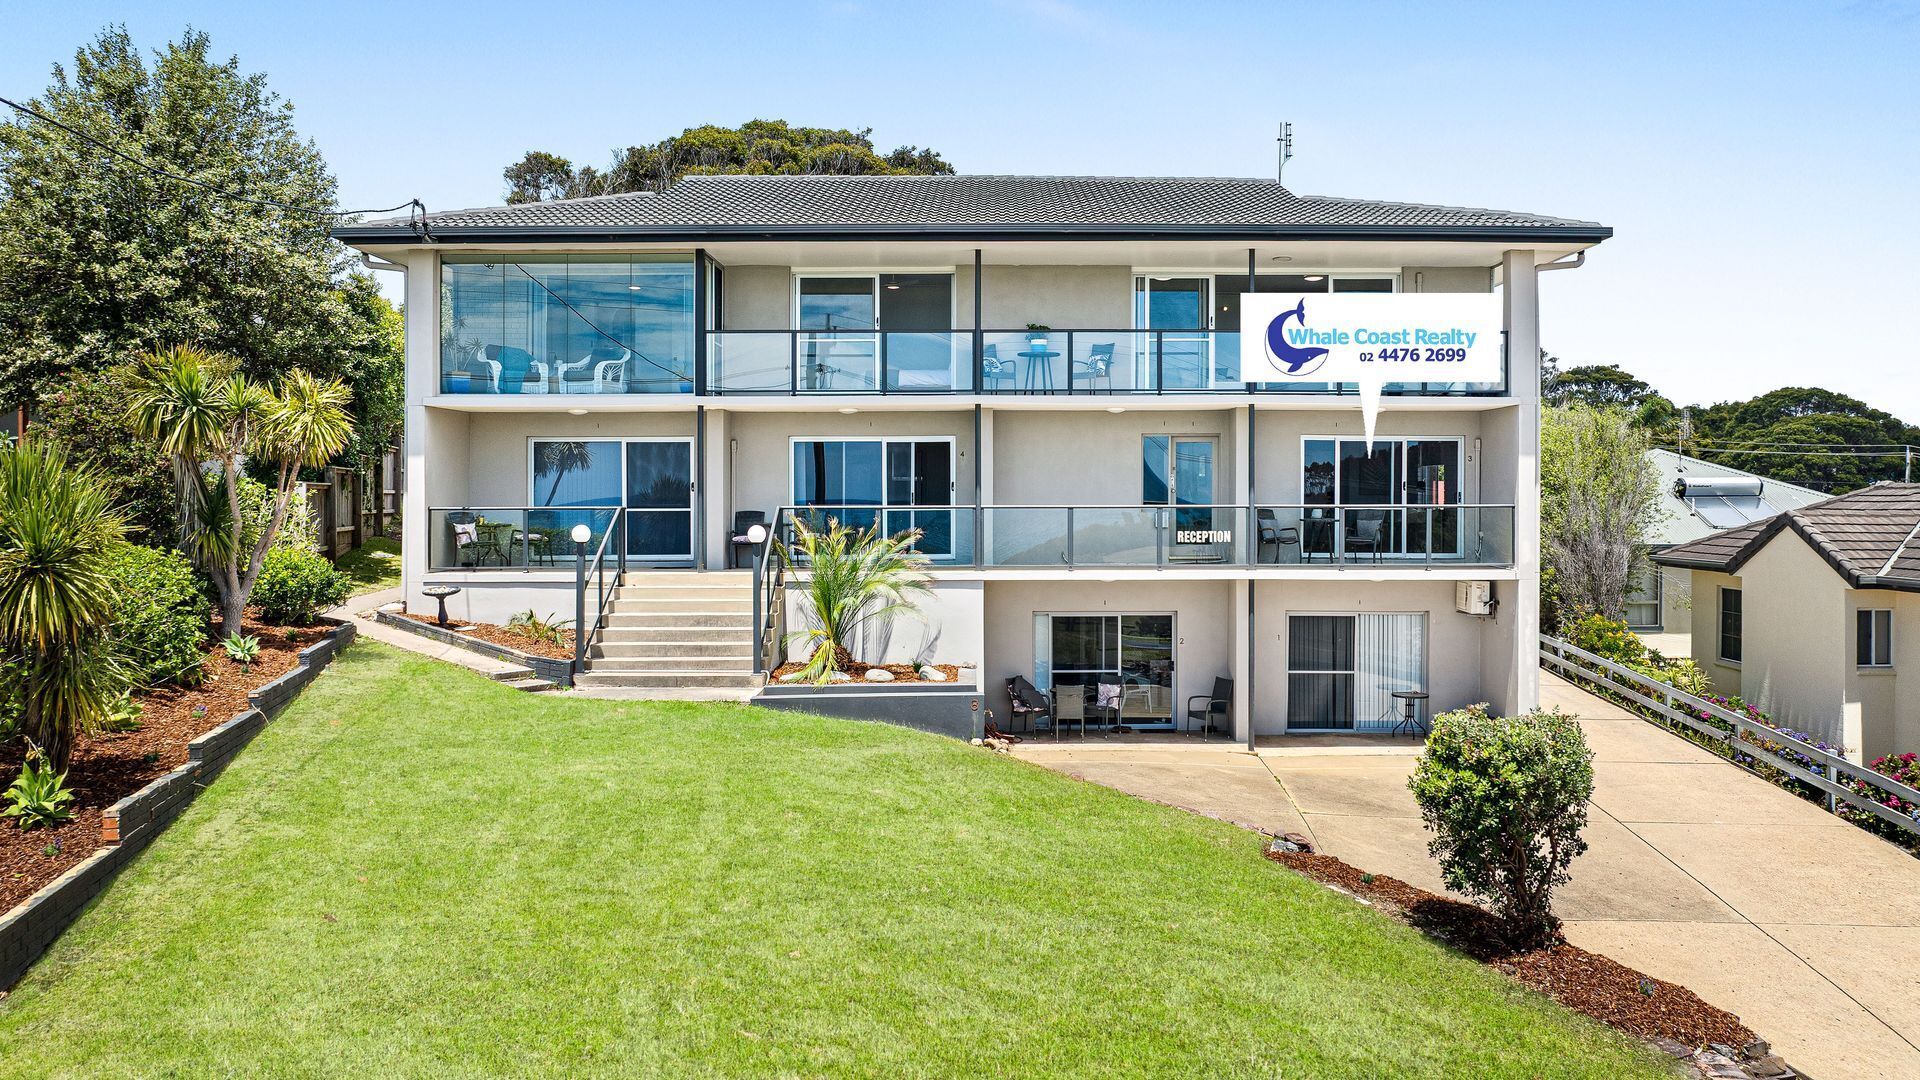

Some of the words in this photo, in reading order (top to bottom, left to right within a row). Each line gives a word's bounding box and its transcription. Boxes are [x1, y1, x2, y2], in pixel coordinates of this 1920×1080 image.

[1467, 455, 1473, 463] 3
[1177, 530, 1231, 543] RECEPTION
[1179, 637, 1185, 645] 2
